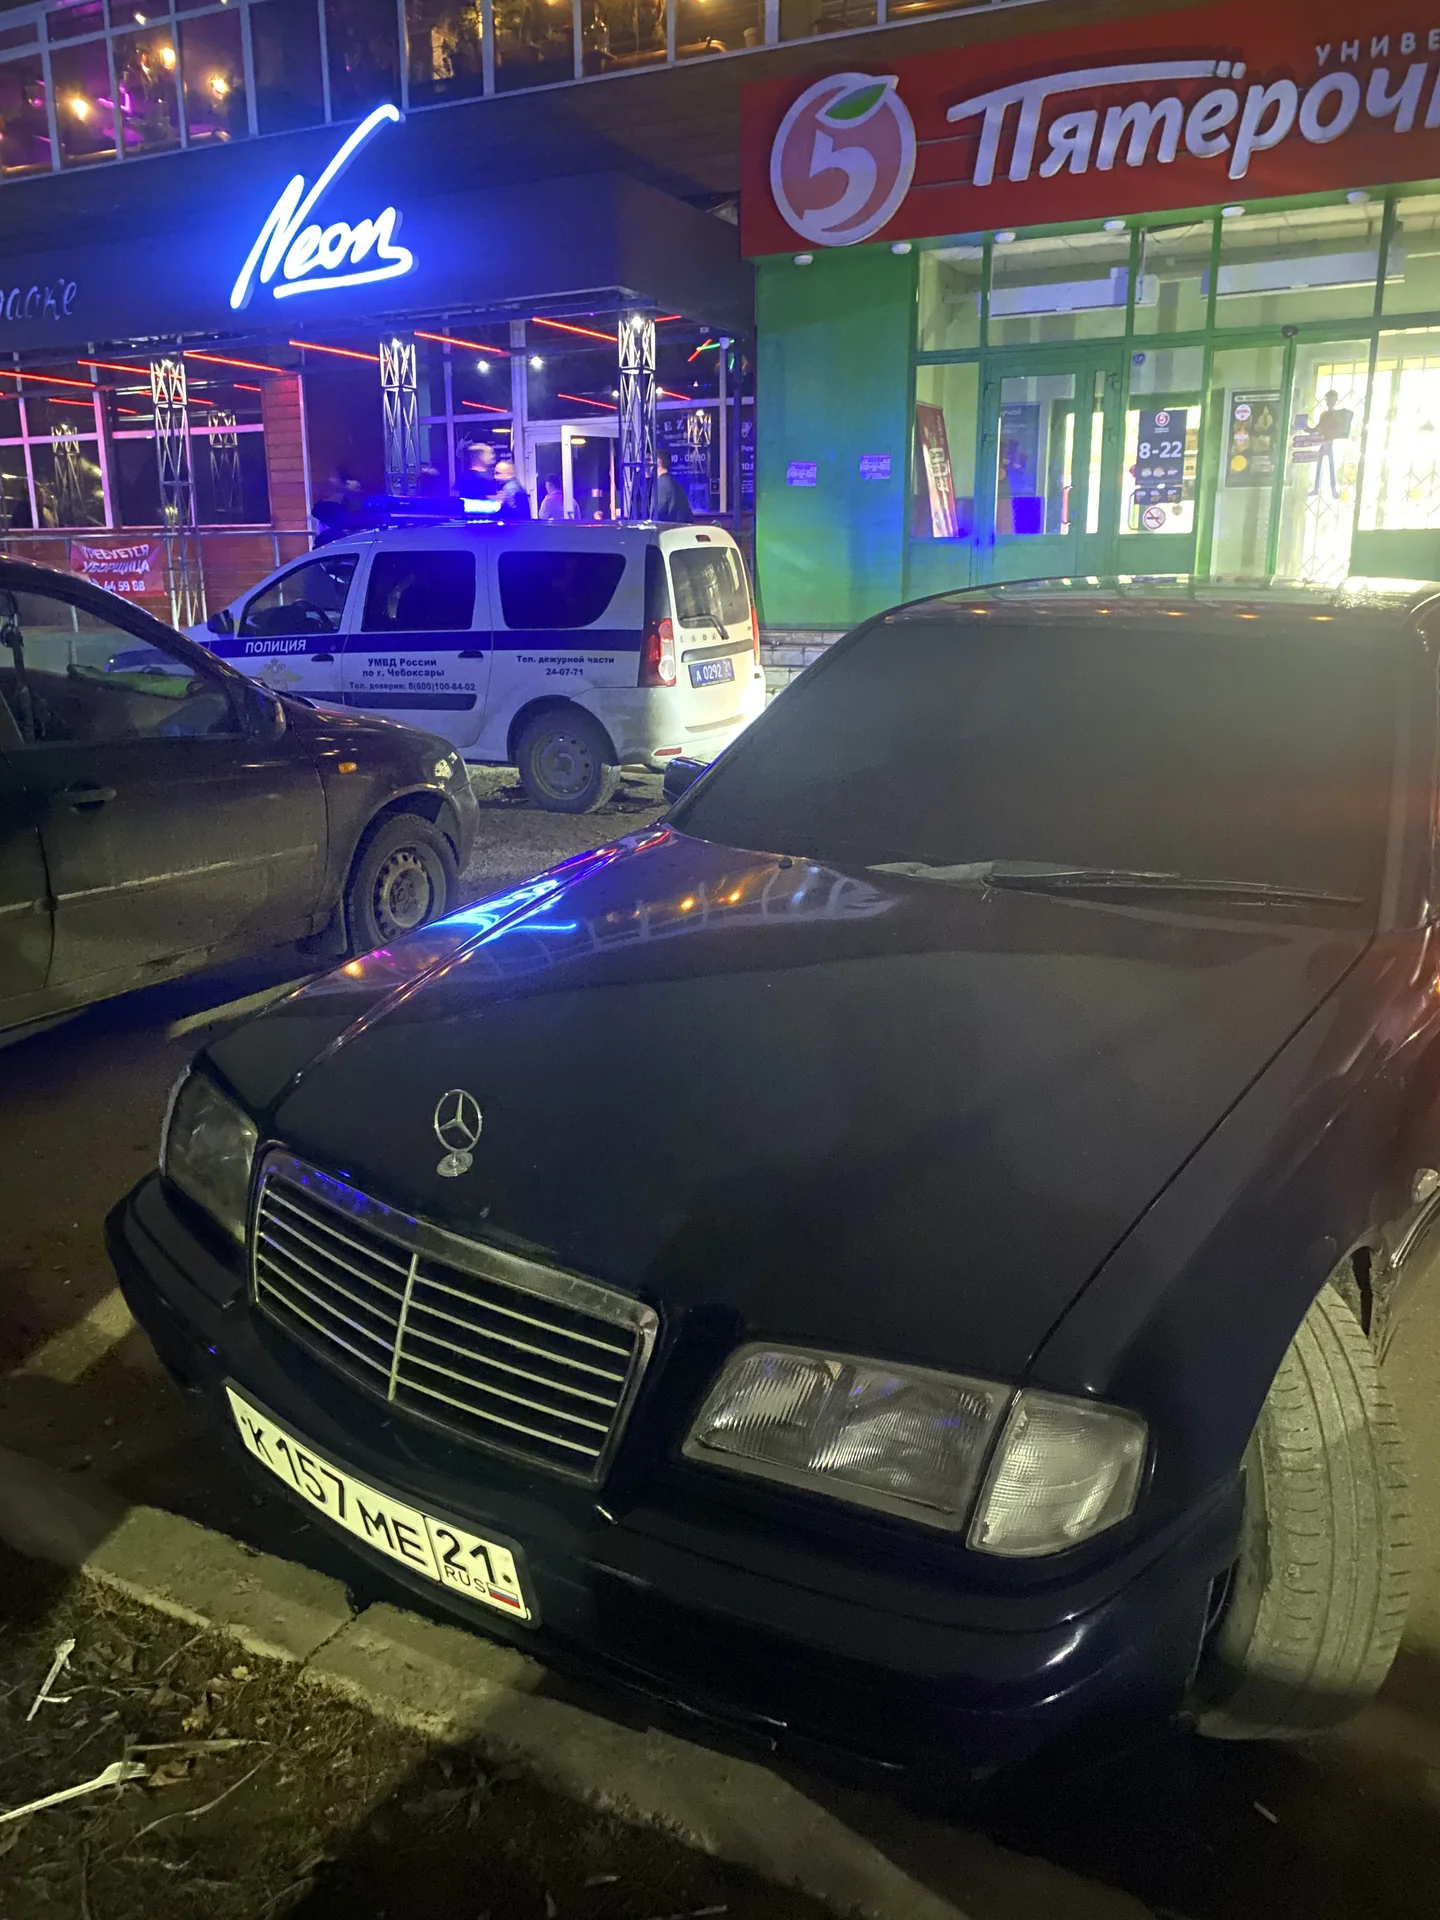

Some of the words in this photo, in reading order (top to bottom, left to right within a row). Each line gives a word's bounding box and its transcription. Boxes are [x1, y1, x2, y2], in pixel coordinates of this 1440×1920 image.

[1315, 27, 1440, 67] УНИВЕ
[947, 59, 1440, 186] Пятёроч
[230, 103, 413, 310] Neon
[1139, 441, 1182, 459] 8-22
[82, 544, 149, 559] ТРЕБУЕТСЯ
[82, 560, 150, 574] УБОРЩИЦА
[680, 632, 717, 643] LADA
[245, 639, 307, 654] ПОЛИЦИЯ
[367, 658, 397, 668] УМВД
[399, 658, 437, 667] России
[516, 655, 537, 663] Тел.
[538, 655, 585, 665] дежурной
[387, 668, 445, 678] Чебоксары
[545, 668, 584, 676] 24-07-71
[349, 681, 368, 690] Тел.
[369, 683, 406, 691] доверия:
[408, 682, 477, 691] 8(800)100-84-02
[436, 1529, 497, 1584] 21
[443, 1564, 487, 1594] RUS
